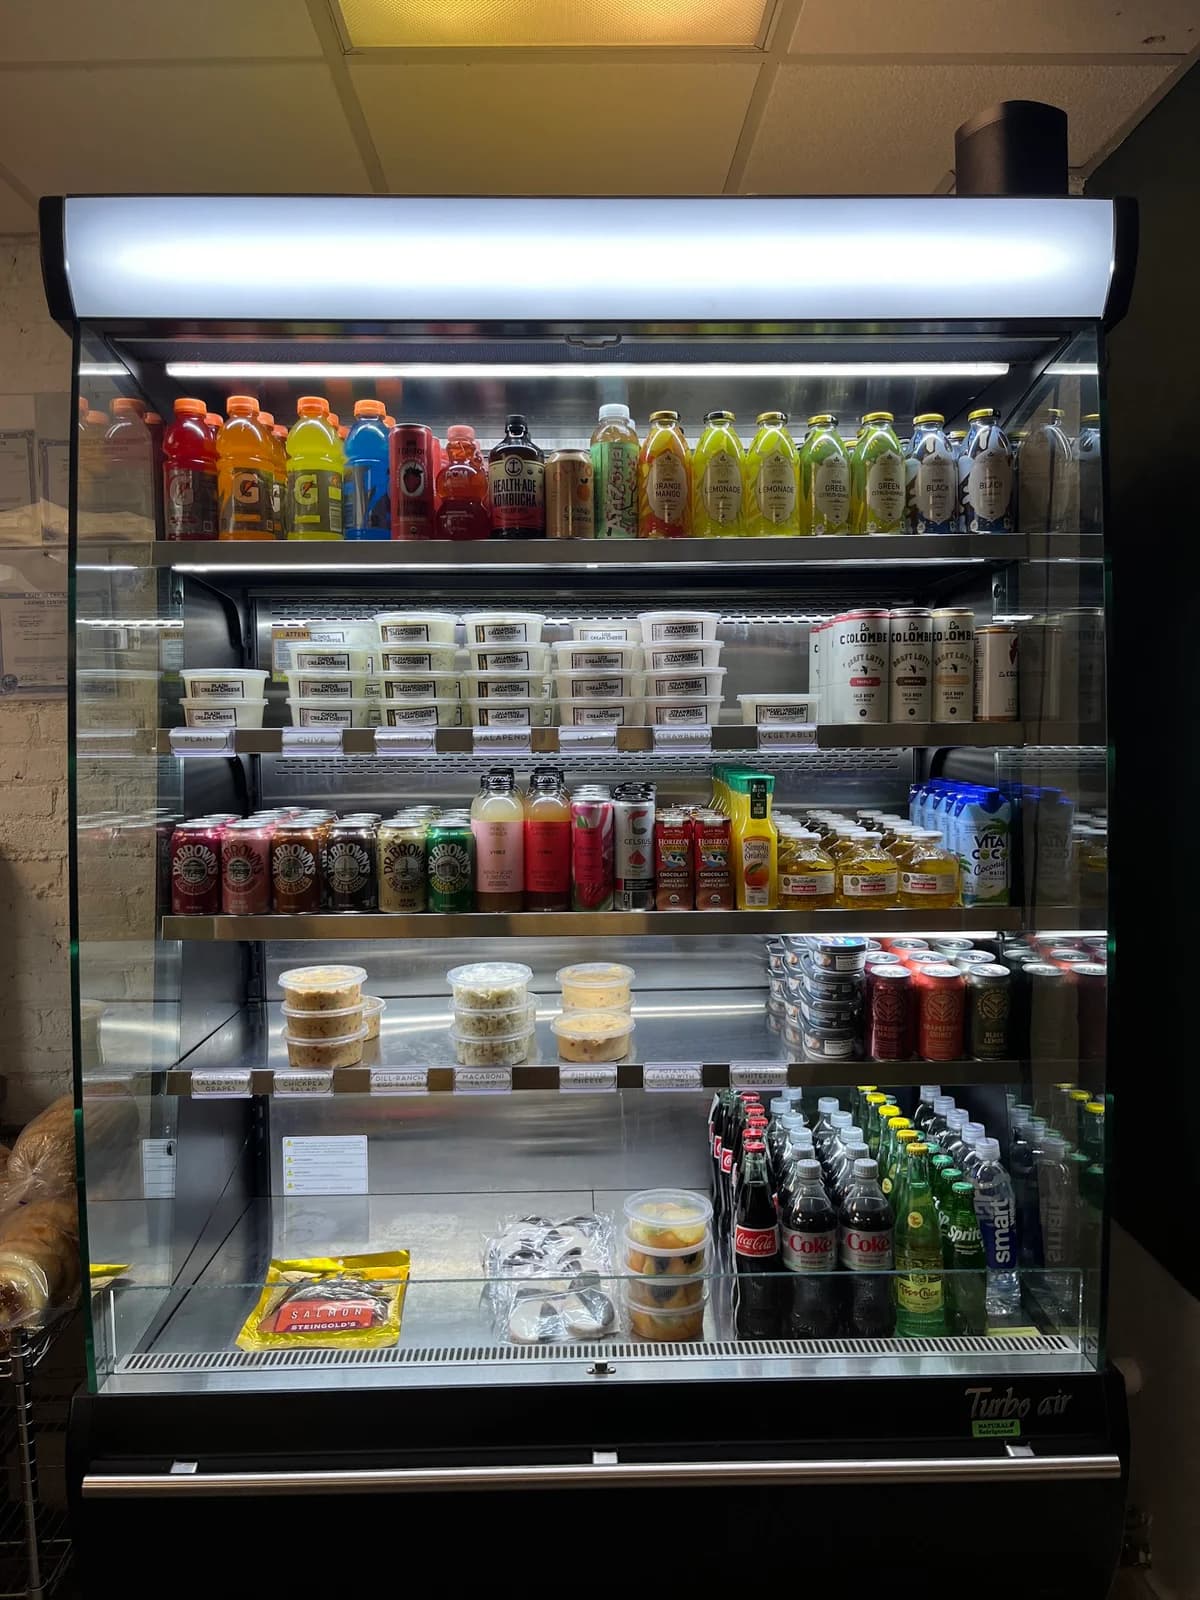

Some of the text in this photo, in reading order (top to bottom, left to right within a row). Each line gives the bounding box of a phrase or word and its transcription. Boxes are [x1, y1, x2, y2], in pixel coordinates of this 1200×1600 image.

[493, 479, 537, 493] HEALTH-ADE
[704, 485, 741, 494] LEMONADE
[758, 485, 794, 494] LEMONADE
[878, 482, 900, 490] GREEN
[493, 493, 537, 507] KOMBUCHA
[846, 632, 888, 643] COLOMBE
[184, 735, 213, 743] PLAIN
[761, 730, 814, 739] VEGETABLE
[297, 736, 326, 744] CHIVE
[658, 838, 689, 848] HORIZON
[698, 838, 729, 848] HORIZON
[788, 1234, 833, 1254] Coke
[846, 1232, 890, 1252] Coke
[290, 1307, 363, 1320] SALMON
[289, 1321, 357, 1331] STEINGOLD'S
[965, 1387, 1073, 1419] Turbo air
